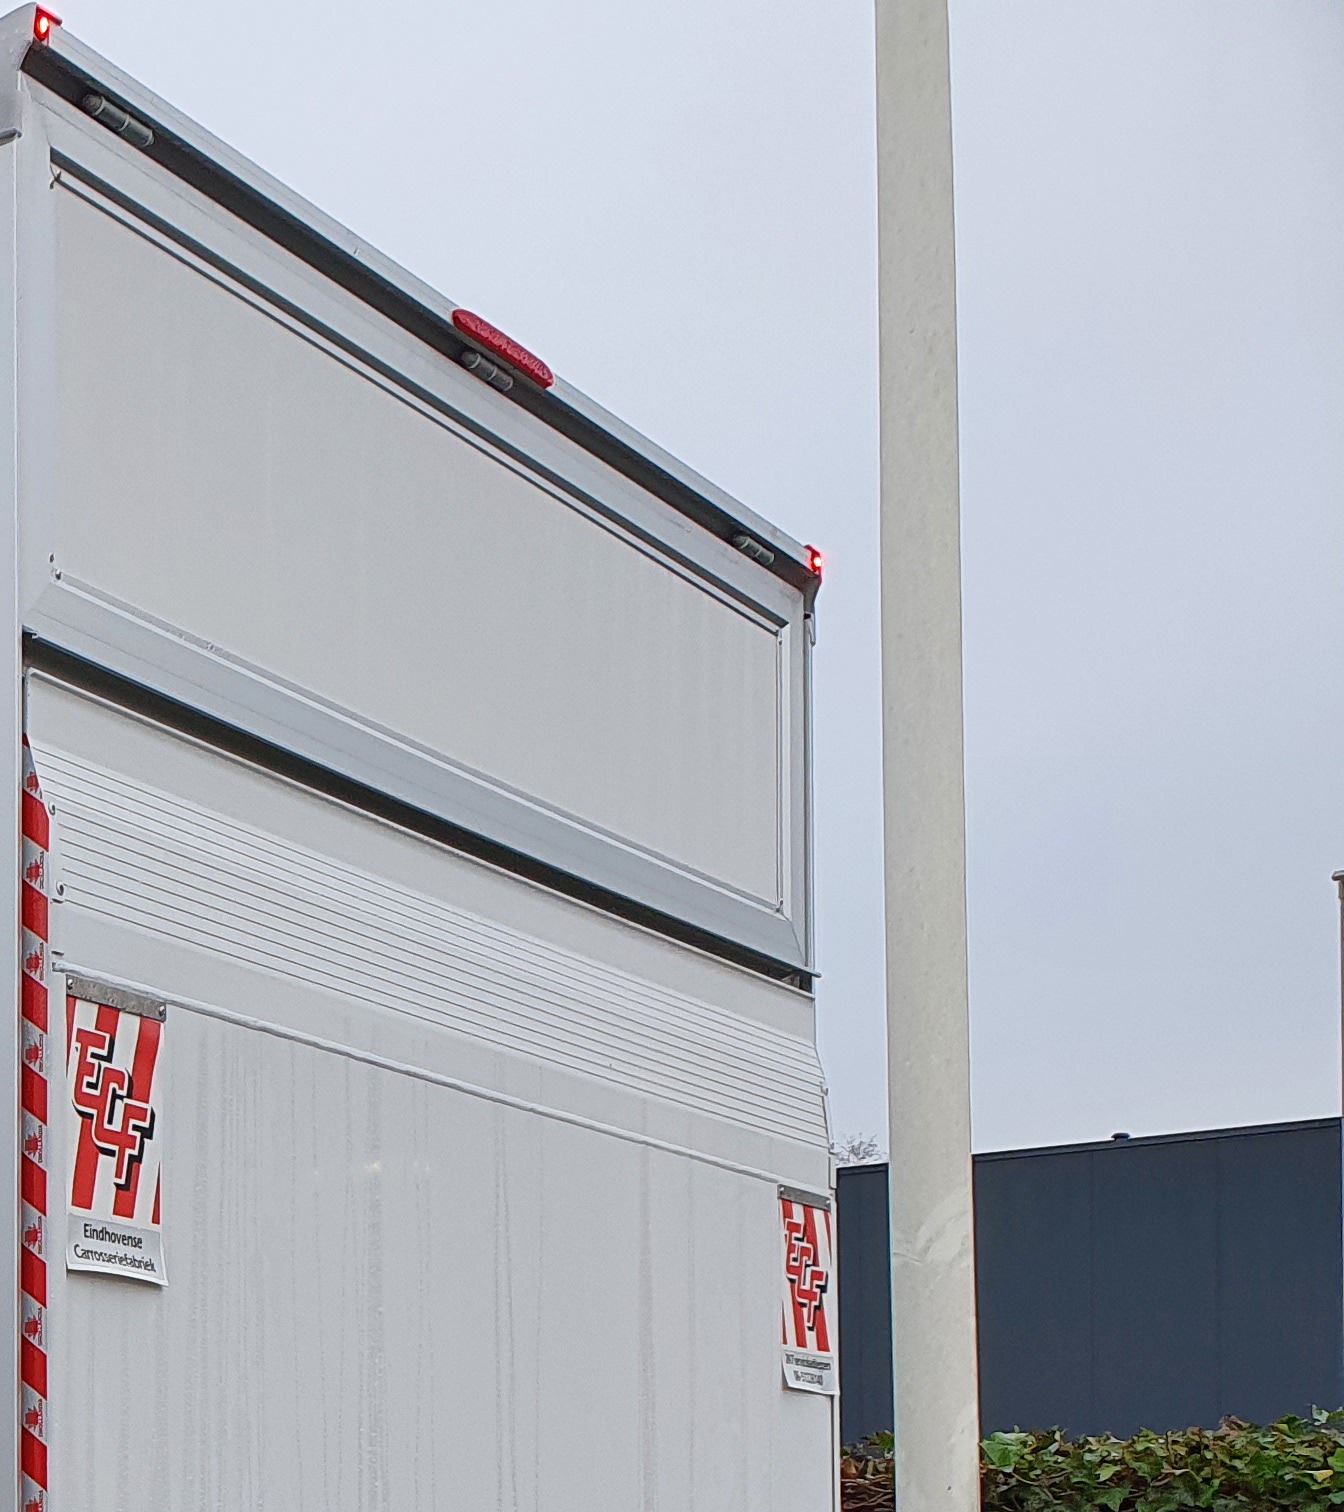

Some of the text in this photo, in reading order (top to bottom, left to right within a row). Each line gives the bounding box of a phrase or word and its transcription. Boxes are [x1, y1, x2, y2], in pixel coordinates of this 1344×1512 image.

[73, 1028, 154, 1188] ECF
[83, 1223, 143, 1249] Eindhovense
[785, 1219, 828, 1330] ECF
